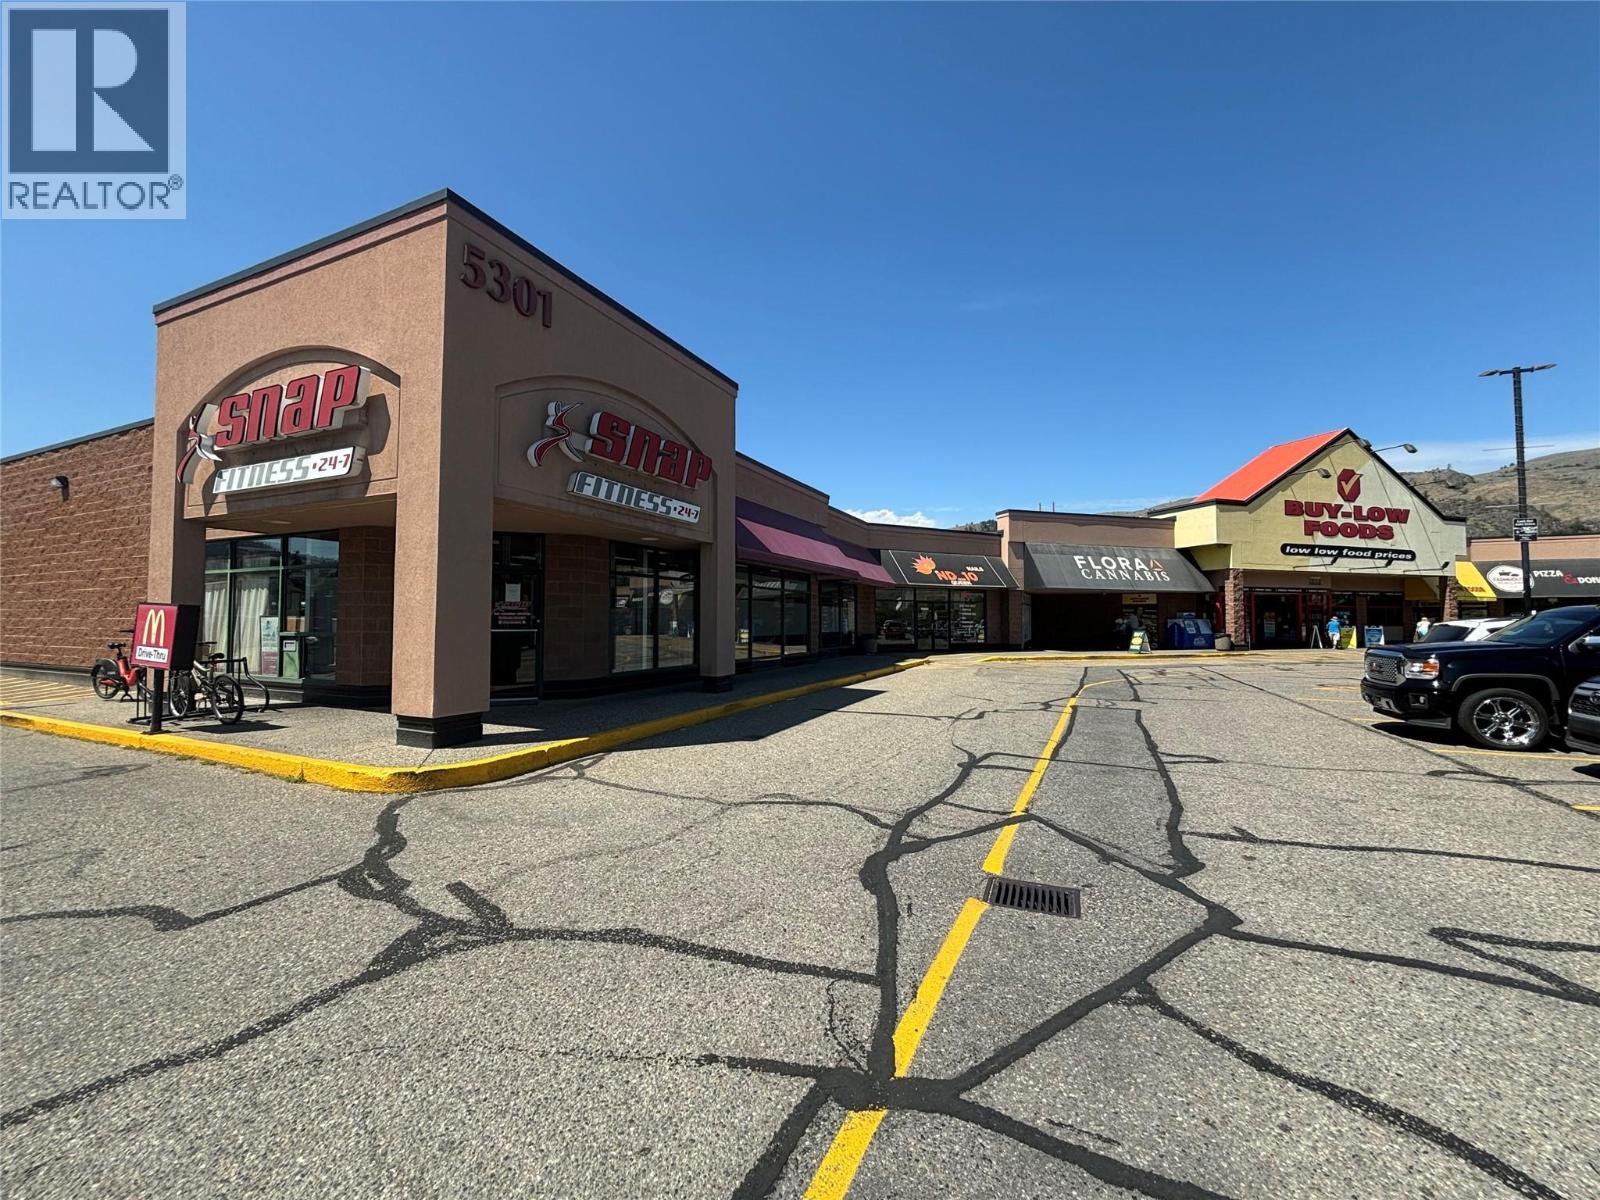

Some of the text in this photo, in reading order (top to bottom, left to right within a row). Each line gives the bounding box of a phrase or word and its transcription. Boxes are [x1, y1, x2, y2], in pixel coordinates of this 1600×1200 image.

[460, 243, 552, 328] 5301
[1284, 500, 1410, 524] BUY-LOW
[1304, 520, 1394, 540] FOODS
[1285, 545, 1412, 560] low low food prices
[1073, 555, 1149, 571] FLORA
[1081, 568, 1170, 582] CANNABIS
[1533, 570, 1563, 578] PIZZA
[1577, 576, 1600, 584] DON
[138, 647, 166, 660] Drive-Thru
